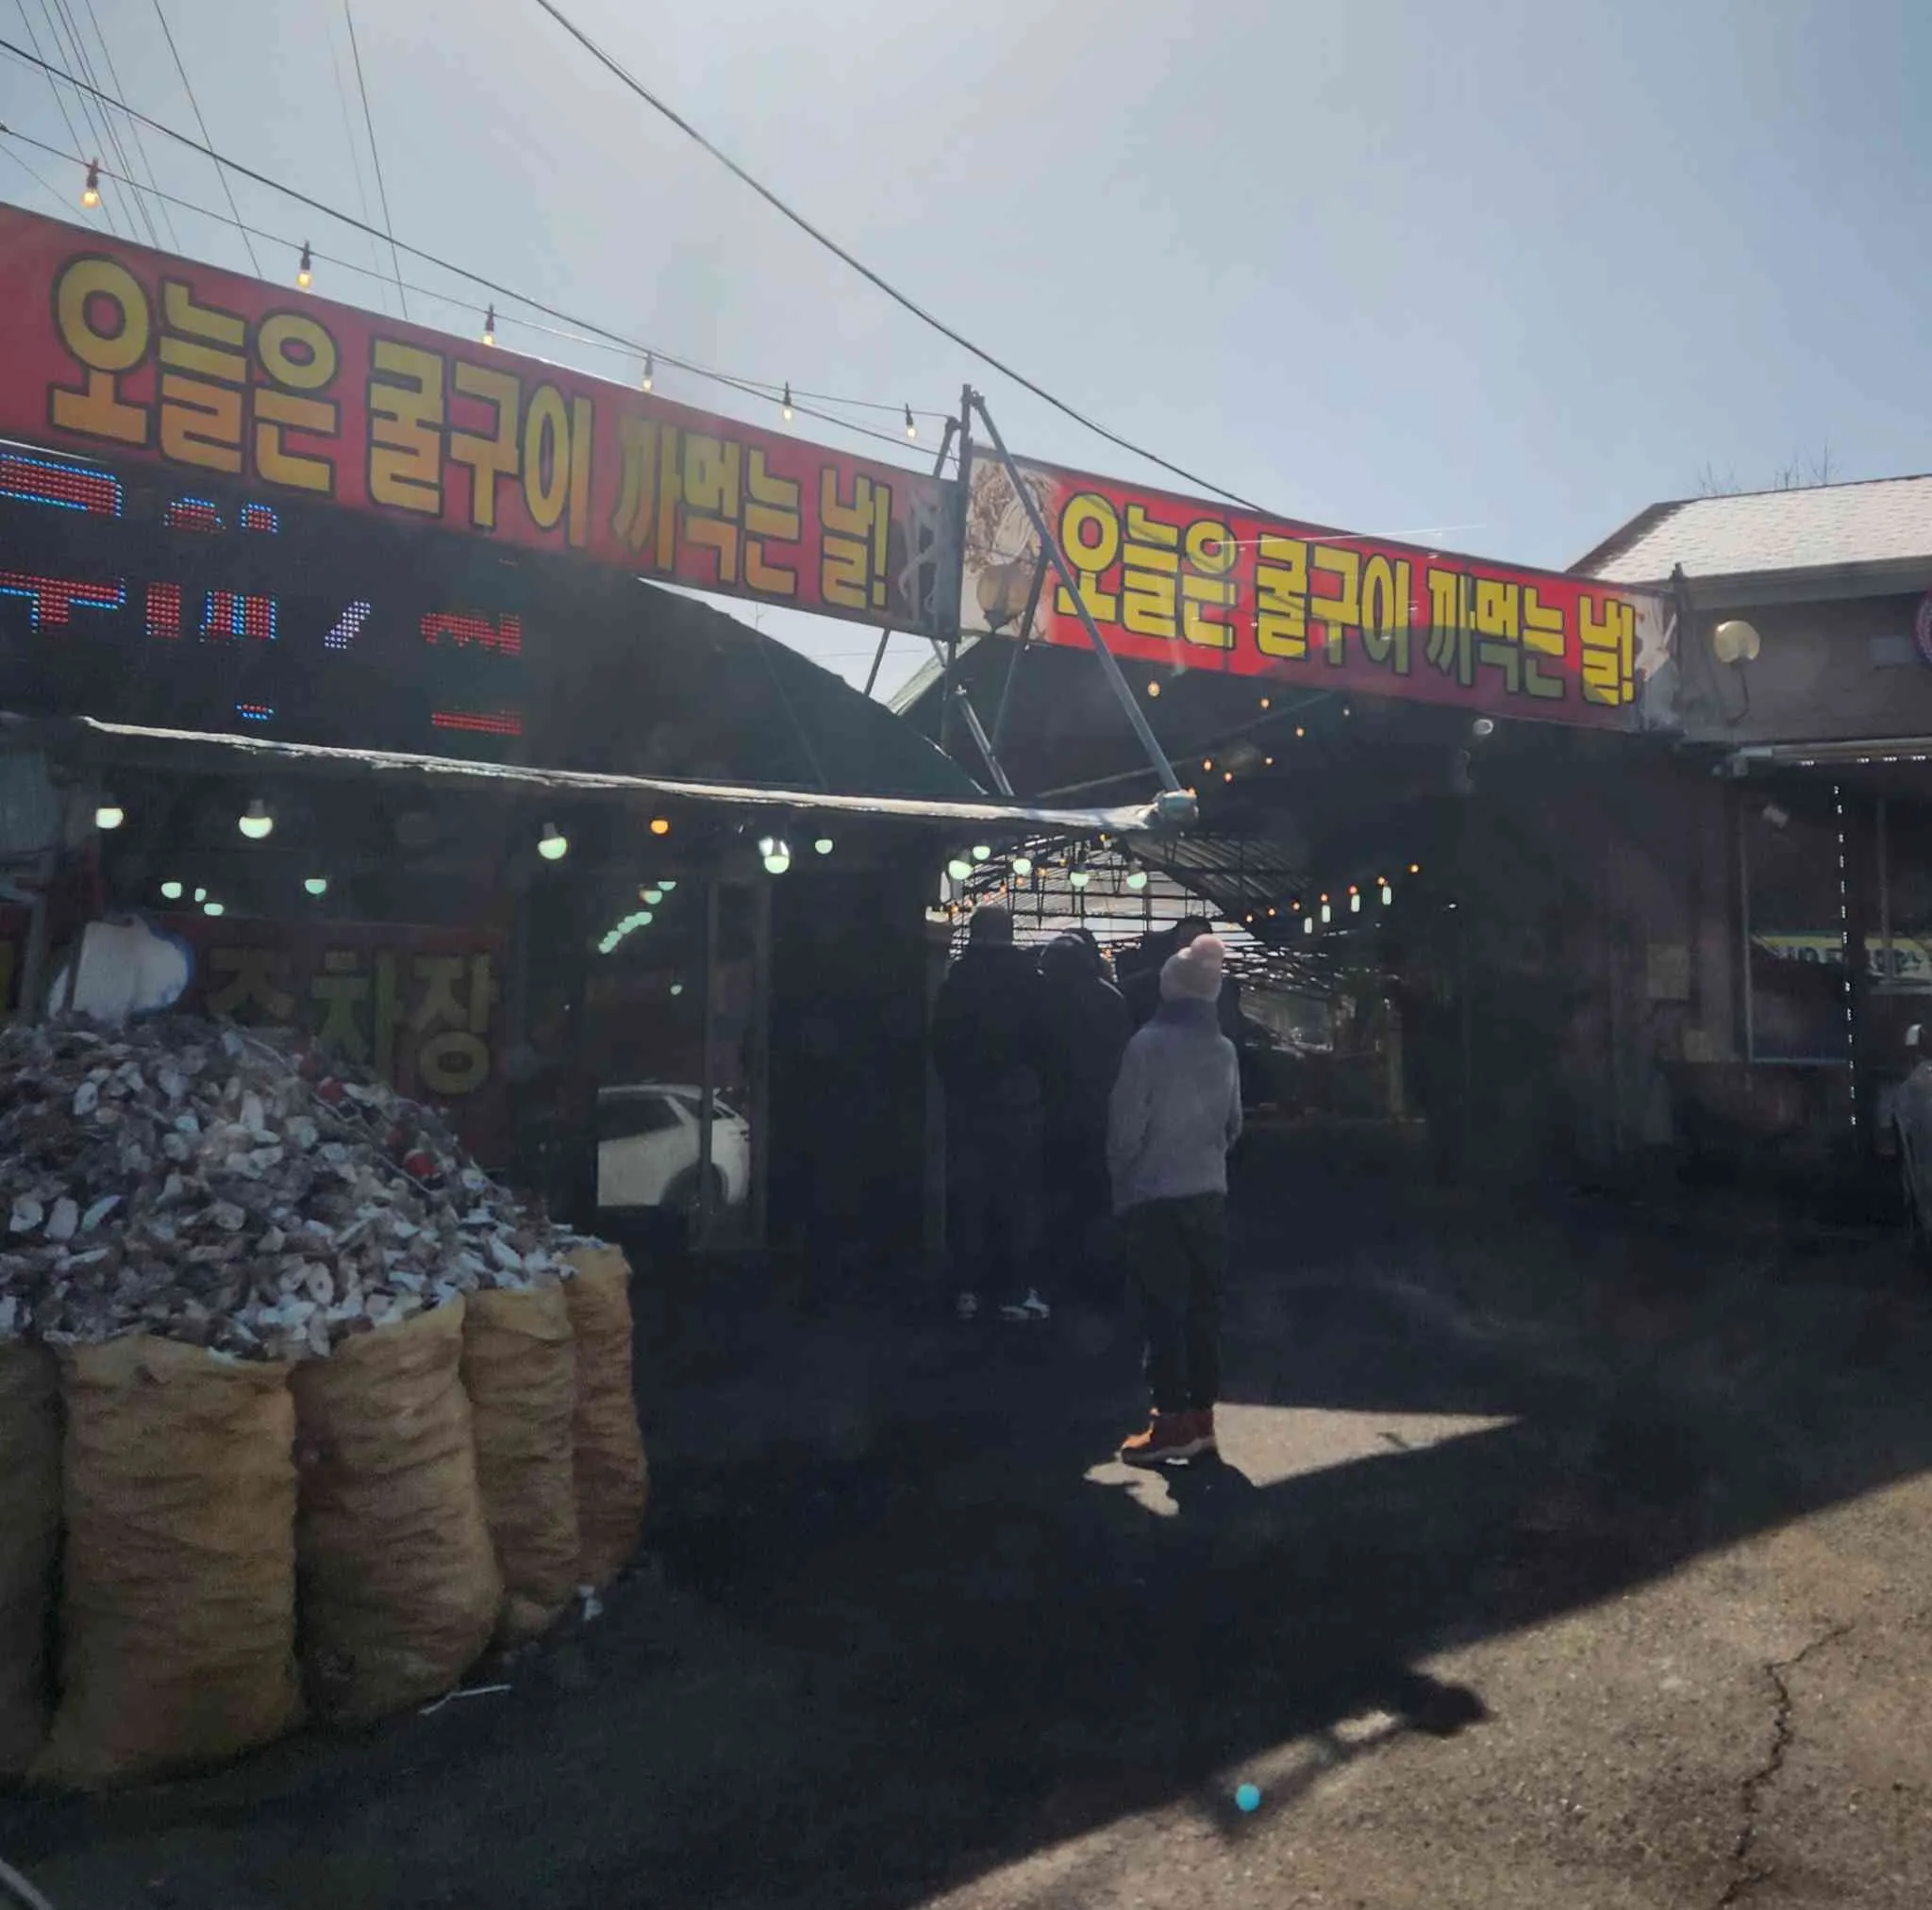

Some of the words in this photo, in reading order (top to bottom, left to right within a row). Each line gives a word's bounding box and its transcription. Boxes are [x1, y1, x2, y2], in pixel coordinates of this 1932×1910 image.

[49, 254, 340, 495] 오늘은
[366, 336, 593, 550] 굴구이
[611, 415, 802, 598] 까먹는
[818, 465, 892, 611] 날!
[1056, 492, 1237, 651] 오늘은
[1255, 532, 1410, 676] 굴구이
[1425, 568, 1567, 700] 까먹는
[1578, 594, 1636, 706] 날!
